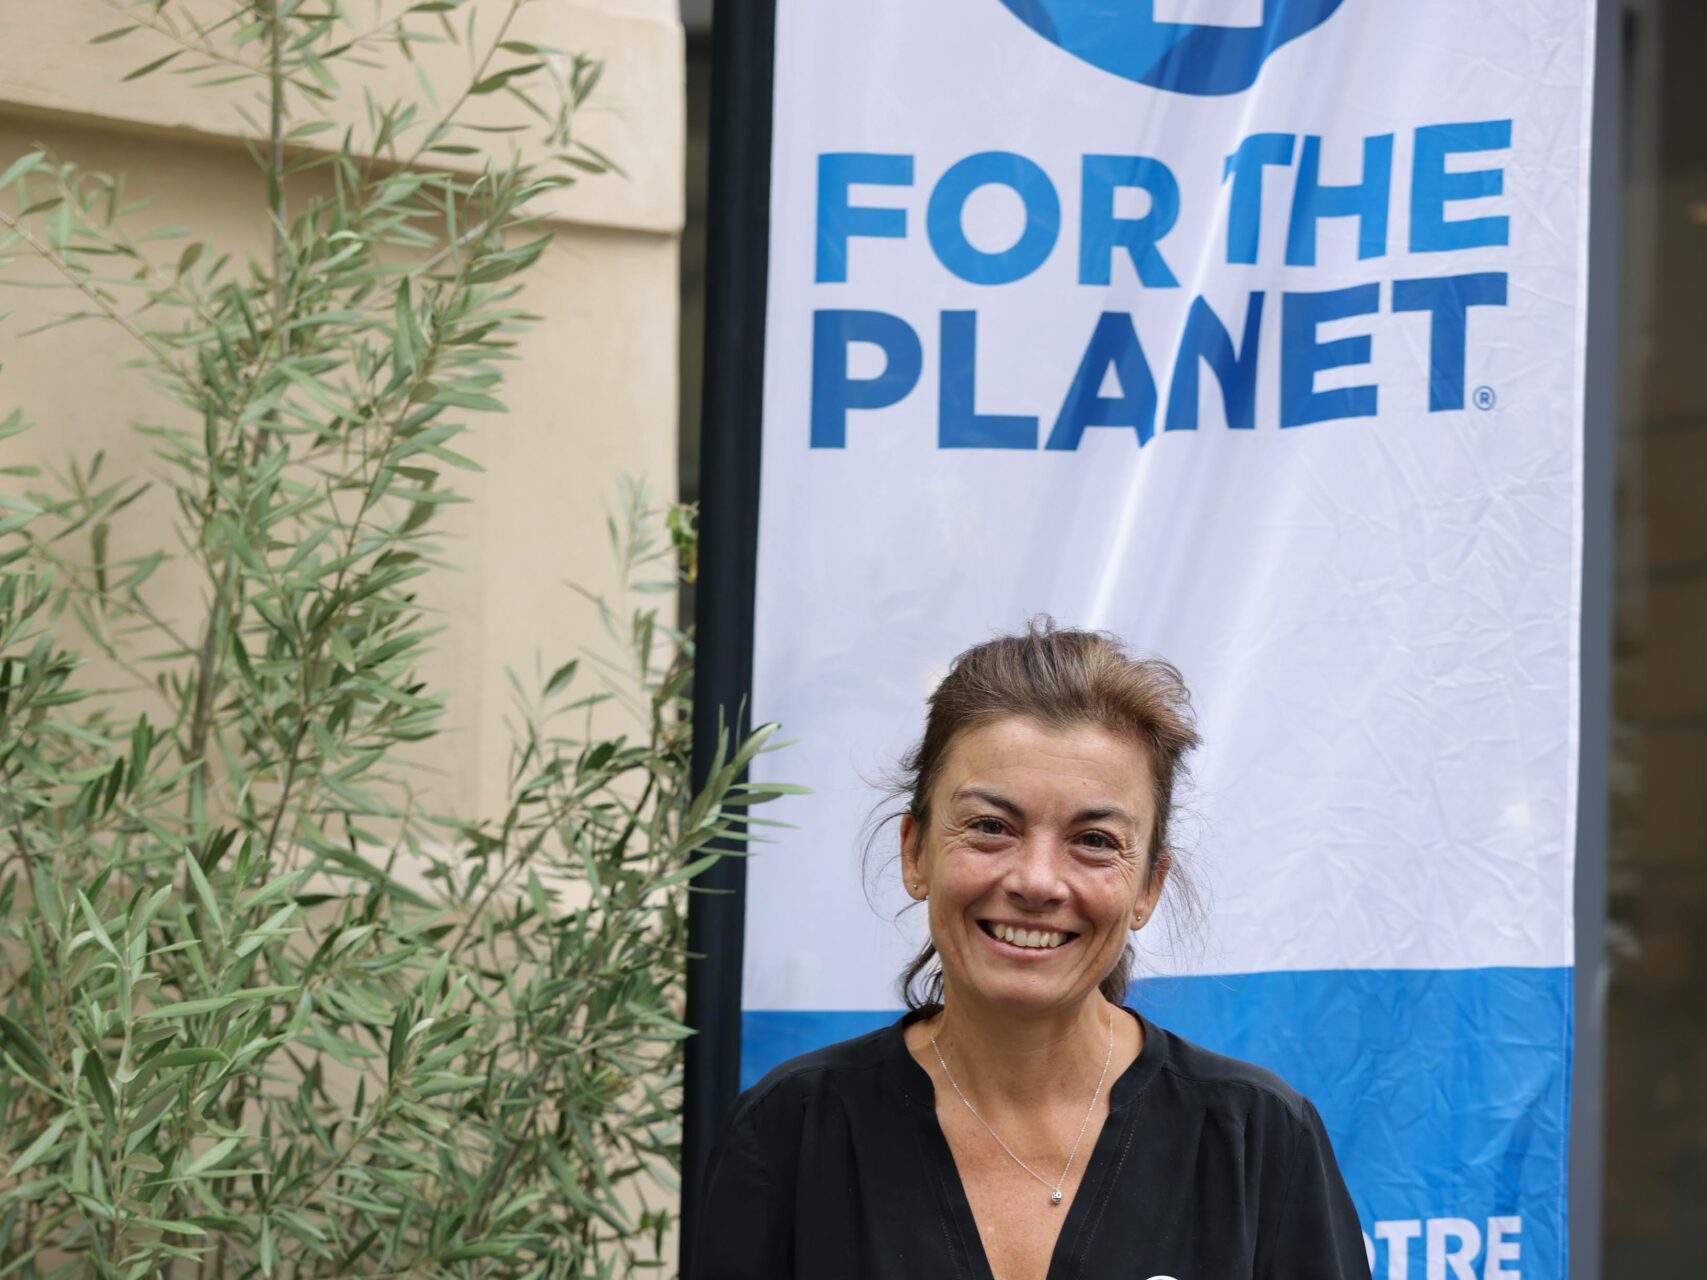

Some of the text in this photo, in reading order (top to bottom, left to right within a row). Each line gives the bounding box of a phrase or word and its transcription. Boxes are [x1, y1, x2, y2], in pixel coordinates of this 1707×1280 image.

[814, 119, 1514, 288] FOR THE
[809, 272, 1509, 451] PLANET
